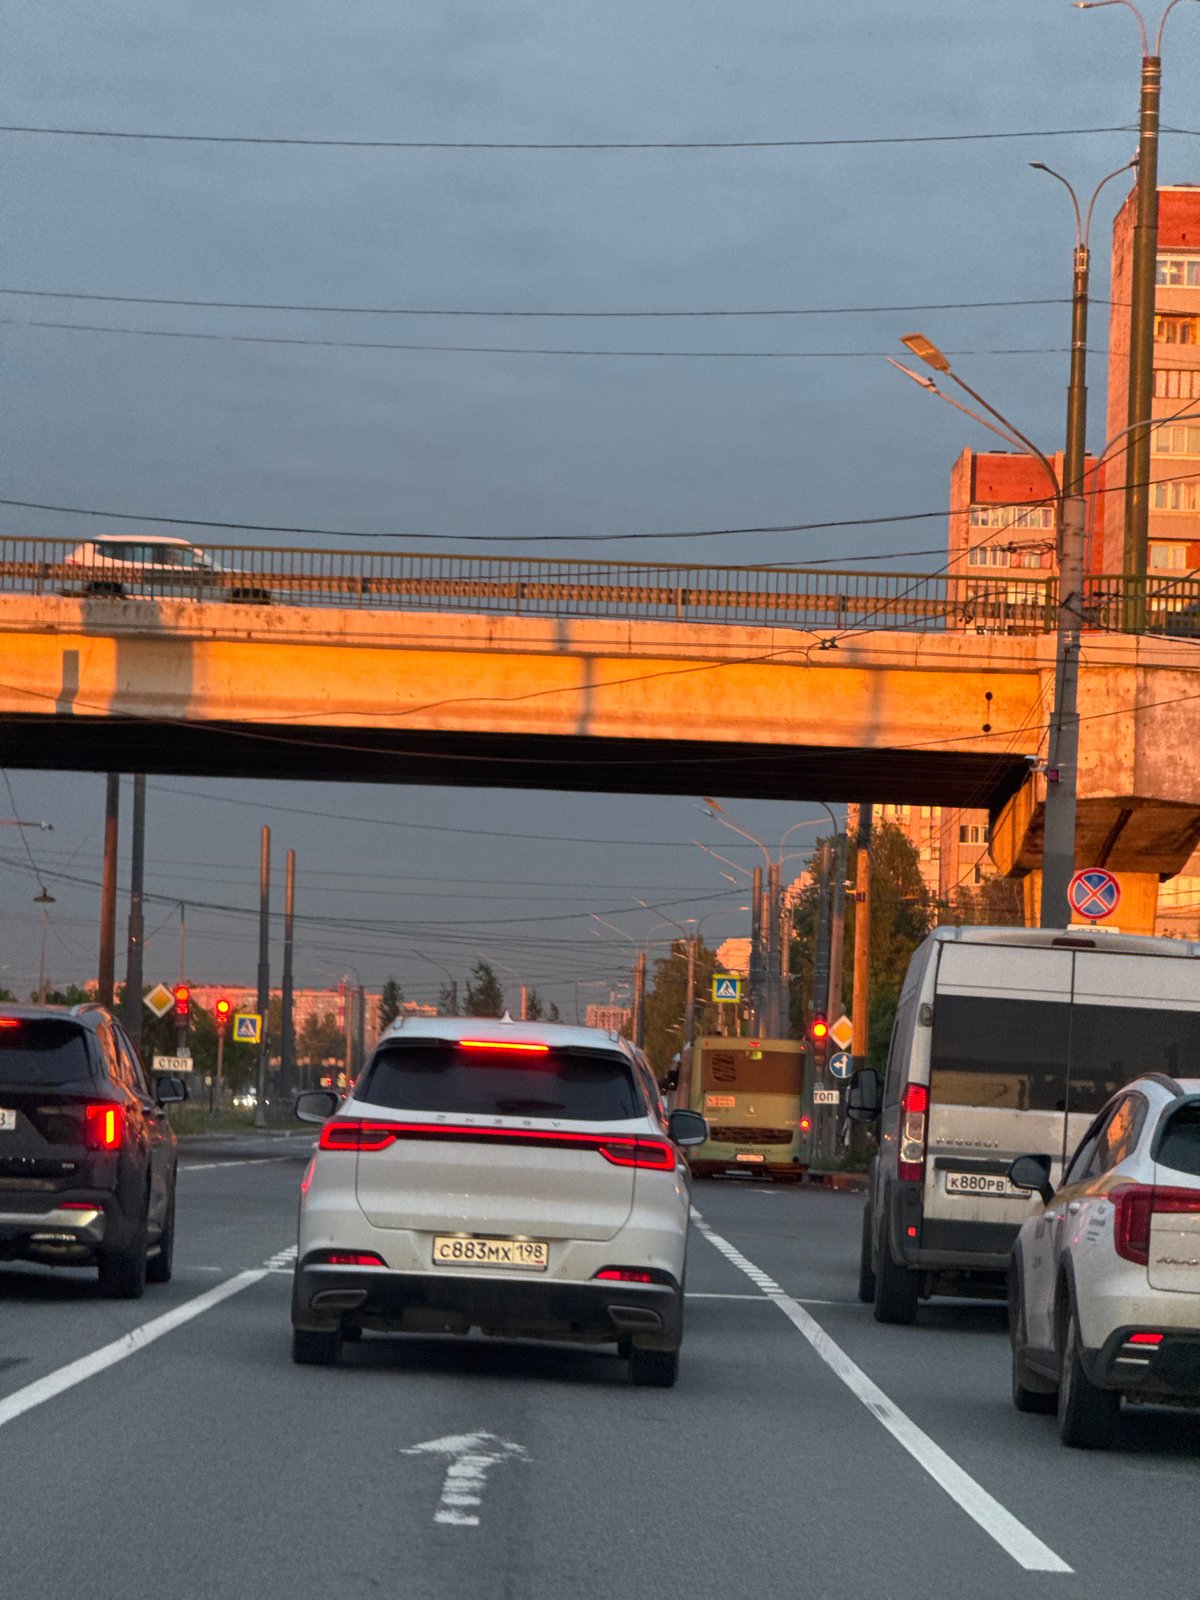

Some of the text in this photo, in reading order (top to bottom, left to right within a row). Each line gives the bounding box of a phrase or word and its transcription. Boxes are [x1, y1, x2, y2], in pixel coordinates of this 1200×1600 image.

[158, 1057, 188, 1069] СТОП
[814, 1092, 834, 1102] ТОП
[516, 1243, 544, 1259] 198
